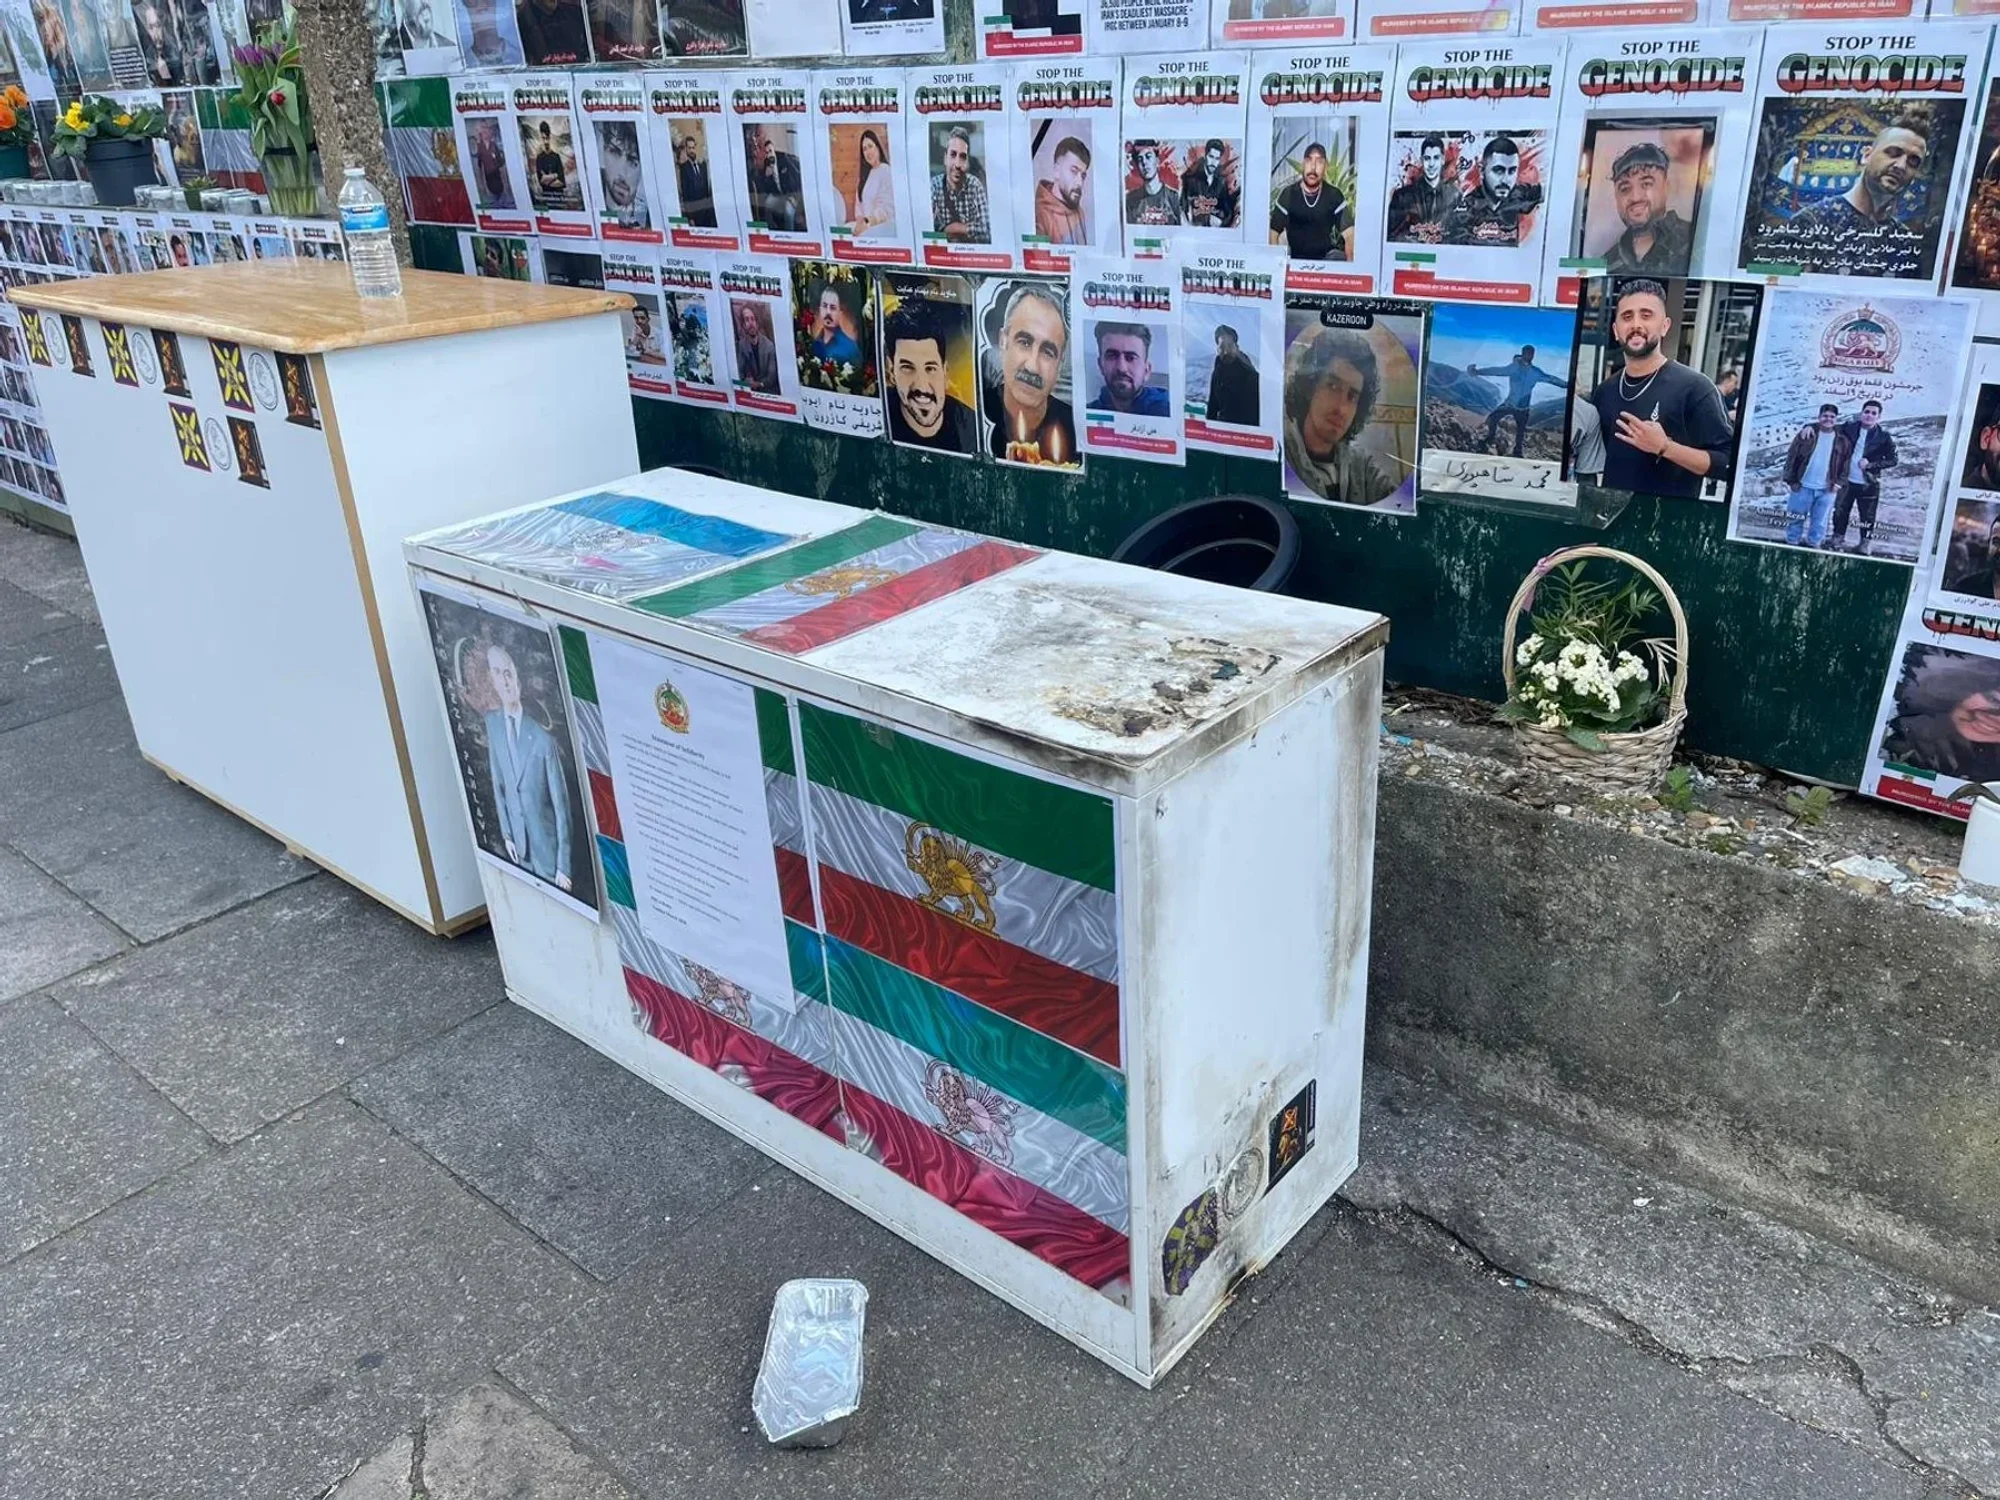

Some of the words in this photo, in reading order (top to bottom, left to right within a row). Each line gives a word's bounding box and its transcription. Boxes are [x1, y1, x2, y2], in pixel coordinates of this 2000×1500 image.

[1120, 7, 1152, 19] DEADLIEST
[1154, 6, 1187, 16] MASSACRE
[1806, 2, 1832, 10] ISLAMIC
[1834, 1, 1867, 9] REPUBLIC
[1119, 19, 1146, 30] BETWEEN
[1148, 17, 1175, 28] JANUARY
[1620, 42, 1662, 55] STOP
[1668, 40, 1700, 53] THE
[1825, 36, 1873, 50] STOP
[1878, 35, 1916, 49] THE
[1290, 57, 1321, 70] STOP
[1323, 56, 1350, 68] THE
[1444, 50, 1480, 63] STOP
[1484, 49, 1513, 62] THE
[1036, 69, 1060, 79] STOP
[1061, 68, 1084, 78] THE
[1158, 62, 1185, 74] STOP
[1188, 61, 1209, 72] THE
[1776, 52, 1967, 93] GENOCIDE
[747, 78, 766, 87] STOP
[768, 78, 782, 86] THE
[836, 77, 855, 86] STOP
[856, 76, 873, 85] THE
[933, 74, 956, 84] STOP
[957, 73, 974, 83] THE
[1406, 64, 1552, 101] GENOCIDE
[1577, 56, 1746, 96] GENOCIDE
[1133, 75, 1240, 107] GENOCIDE
[1260, 70, 1384, 106] GENOCIDE
[731, 88, 806, 114] GENOCIDE
[819, 87, 898, 114] GENOCIDE
[914, 85, 1002, 114] GENOCIDE
[1017, 80, 1113, 111] GENOCIDE
[1758, 223, 1800, 237] شاهرود
[1800, 224, 1829, 238] دلاور
[1888, 229, 1923, 241] سعید
[1198, 257, 1223, 268] STOP
[1225, 258, 1246, 269] THE
[1102, 272, 1125, 282] STOP
[1126, 273, 1144, 283] THE
[1083, 281, 1171, 311] GENOCIDE
[1326, 313, 1367, 326] KAZEROON
[1922, 607, 2000, 641] GEN
